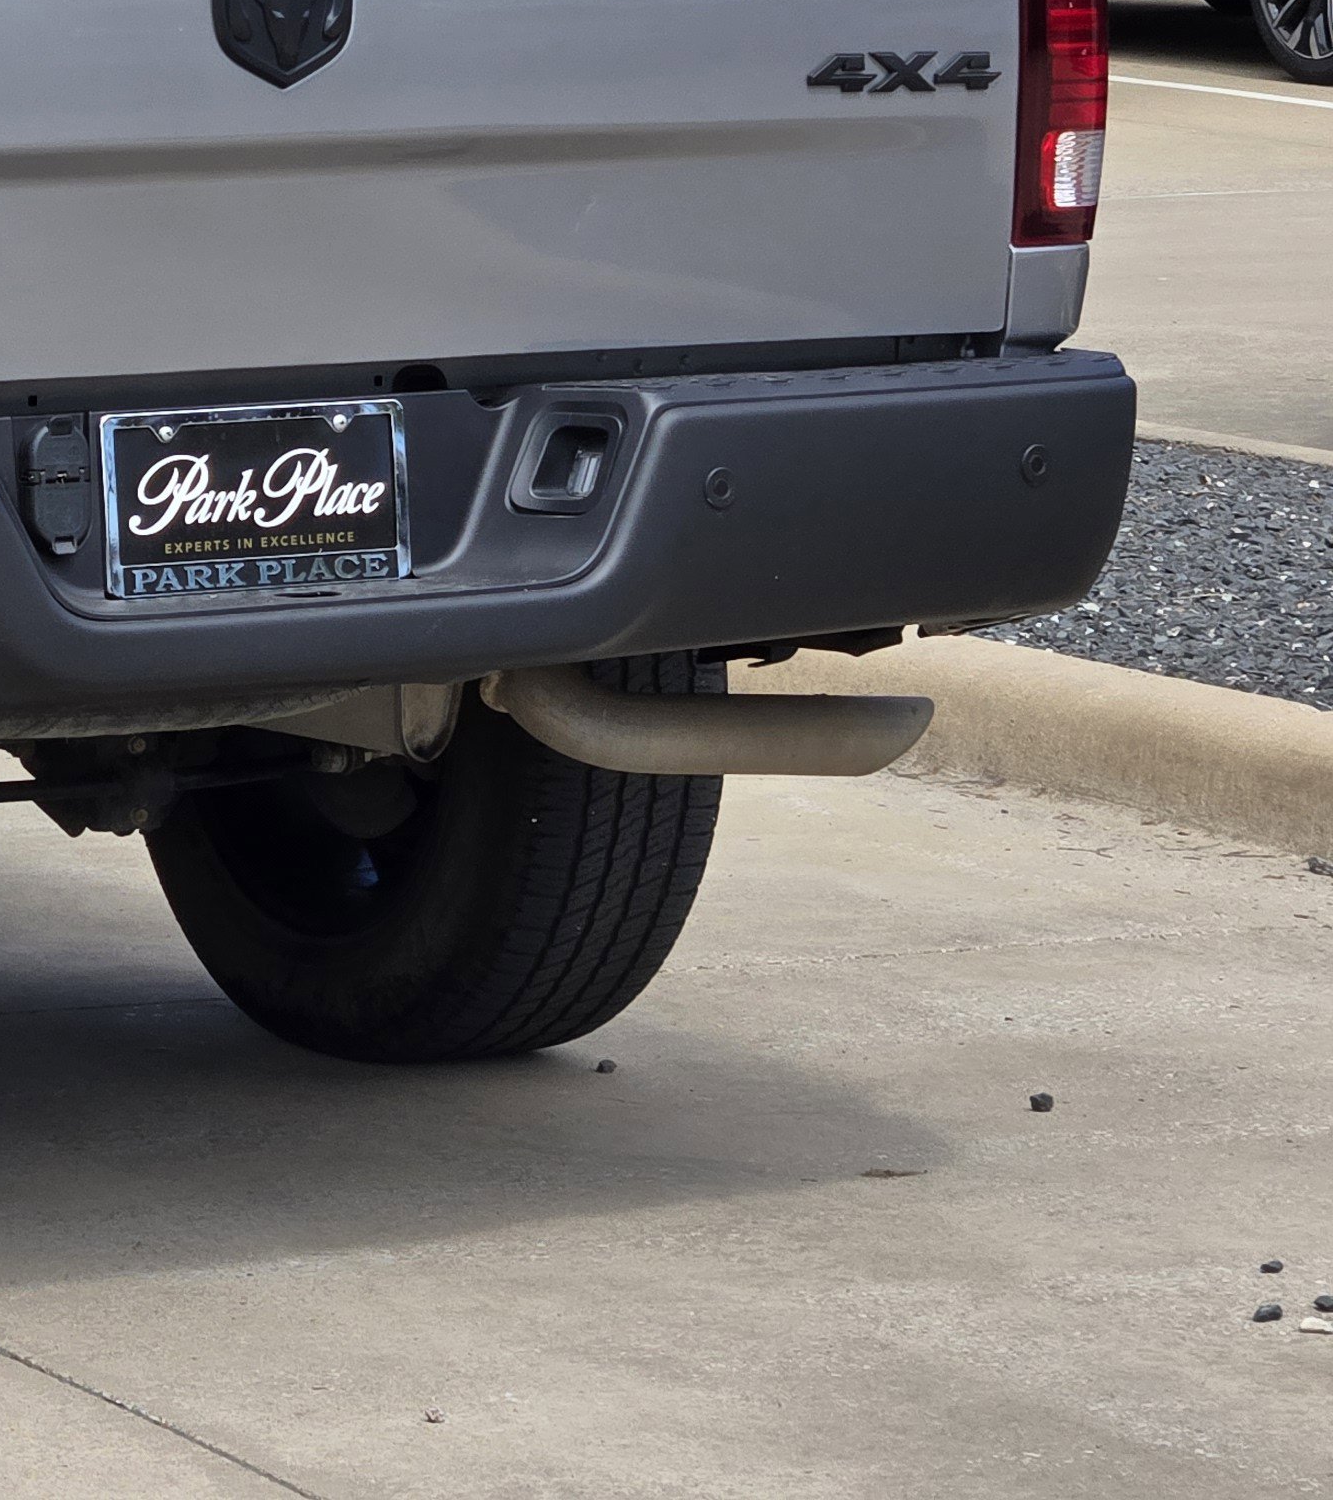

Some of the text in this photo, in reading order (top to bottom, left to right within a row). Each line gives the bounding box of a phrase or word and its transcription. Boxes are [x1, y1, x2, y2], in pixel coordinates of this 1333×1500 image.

[807, 51, 1002, 93] 4X4
[129, 447, 385, 535] Park Place
[164, 531, 356, 554] EXPERTS IN EXCELLENCE
[132, 552, 389, 593] PARK PLACE
